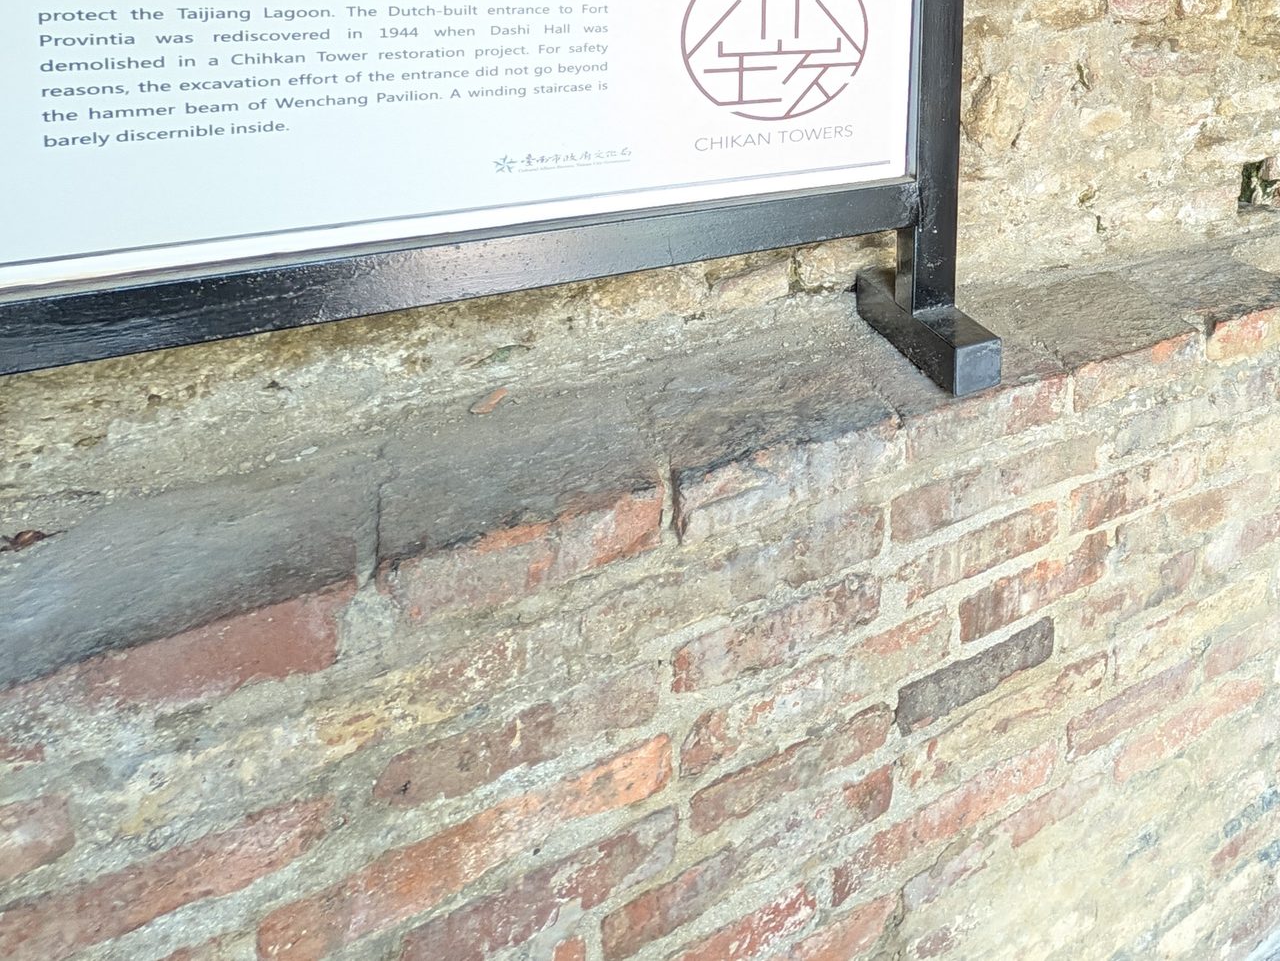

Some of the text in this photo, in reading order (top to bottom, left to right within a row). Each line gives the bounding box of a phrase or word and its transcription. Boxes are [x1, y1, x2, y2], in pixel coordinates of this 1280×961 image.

[38, 4, 608, 25] protect the Taijiang Lagoon. The Dutch-built entrance to Fort
[39, 33, 135, 47] Provintia
[155, 35, 194, 44] was
[213, 28, 330, 42] rediscovered
[348, 28, 362, 39] in
[380, 27, 418, 38] 1944
[434, 26, 475, 37] when
[491, 24, 529, 35] Dashi
[545, 24, 570, 34] Hall
[40, 43, 608, 72] demolished in a Chihkan Tower restoration project. For safety
[41, 62, 607, 97] reasons, the excavation effort of the entrance did not go beyond
[41, 109, 78, 122] the
[89, 106, 176, 120] hammer
[185, 102, 239, 114] beam
[248, 98, 268, 110] of
[275, 95, 368, 109] Wenchang
[377, 91, 442, 103] Pavilion.
[450, 89, 461, 98] A
[468, 86, 526, 98] winding
[534, 83, 592, 94] staircase
[43, 121, 290, 147] barely discernible inside.
[695, 125, 852, 151] CHIKAN TOWERS
